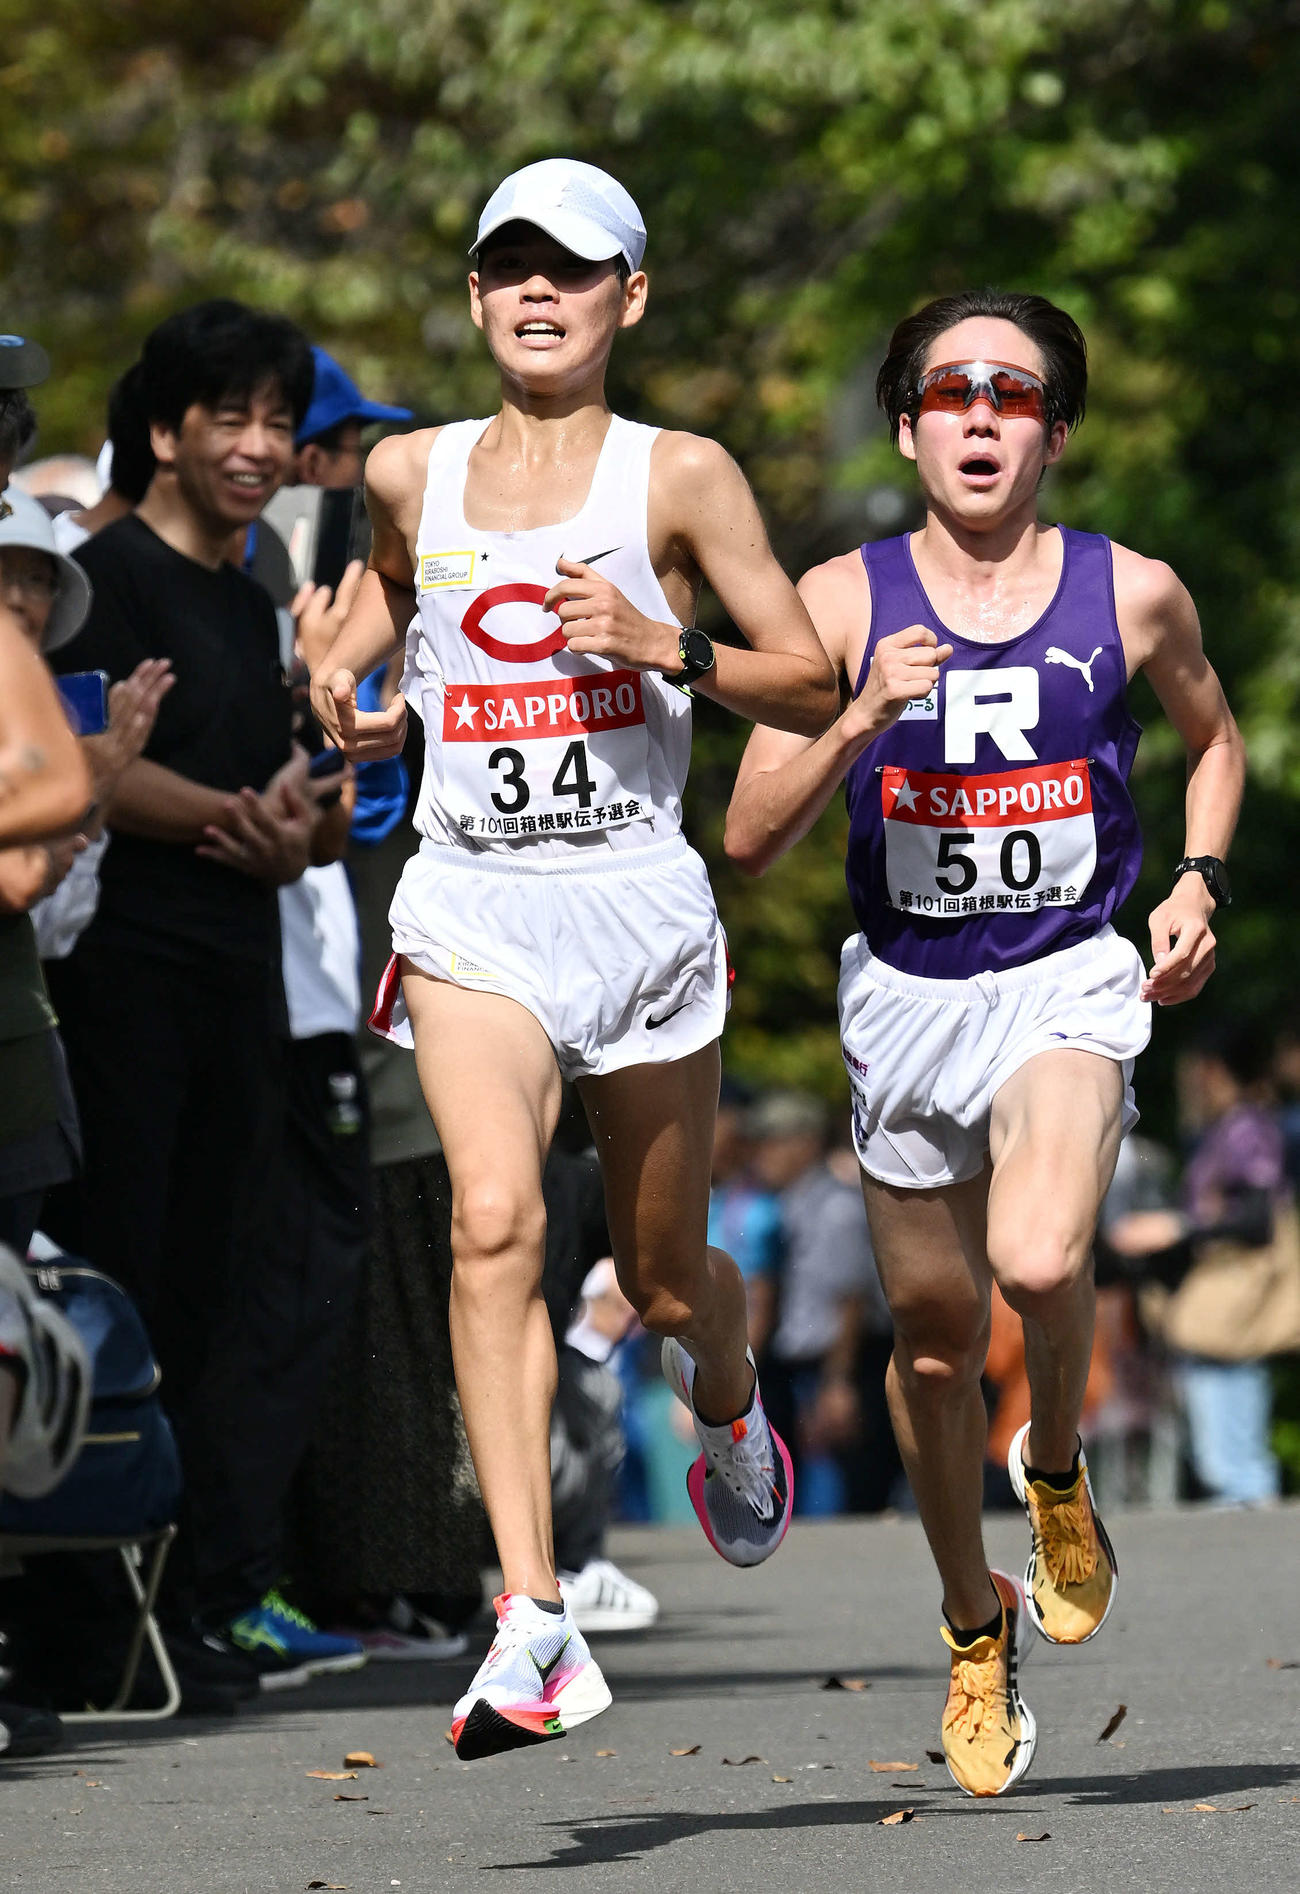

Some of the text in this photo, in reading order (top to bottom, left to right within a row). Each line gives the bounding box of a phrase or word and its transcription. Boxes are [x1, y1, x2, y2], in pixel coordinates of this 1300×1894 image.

[424, 571, 468, 583] FINANCIAL GROUP
[484, 683, 636, 731] SAPPORO
[944, 666, 1039, 764] R
[929, 775, 1084, 816] SAPPORO
[459, 799, 641, 835] 第101回箱根駅伝予選会
[899, 885, 1077, 912] 第101回箱根駅伝予選会
